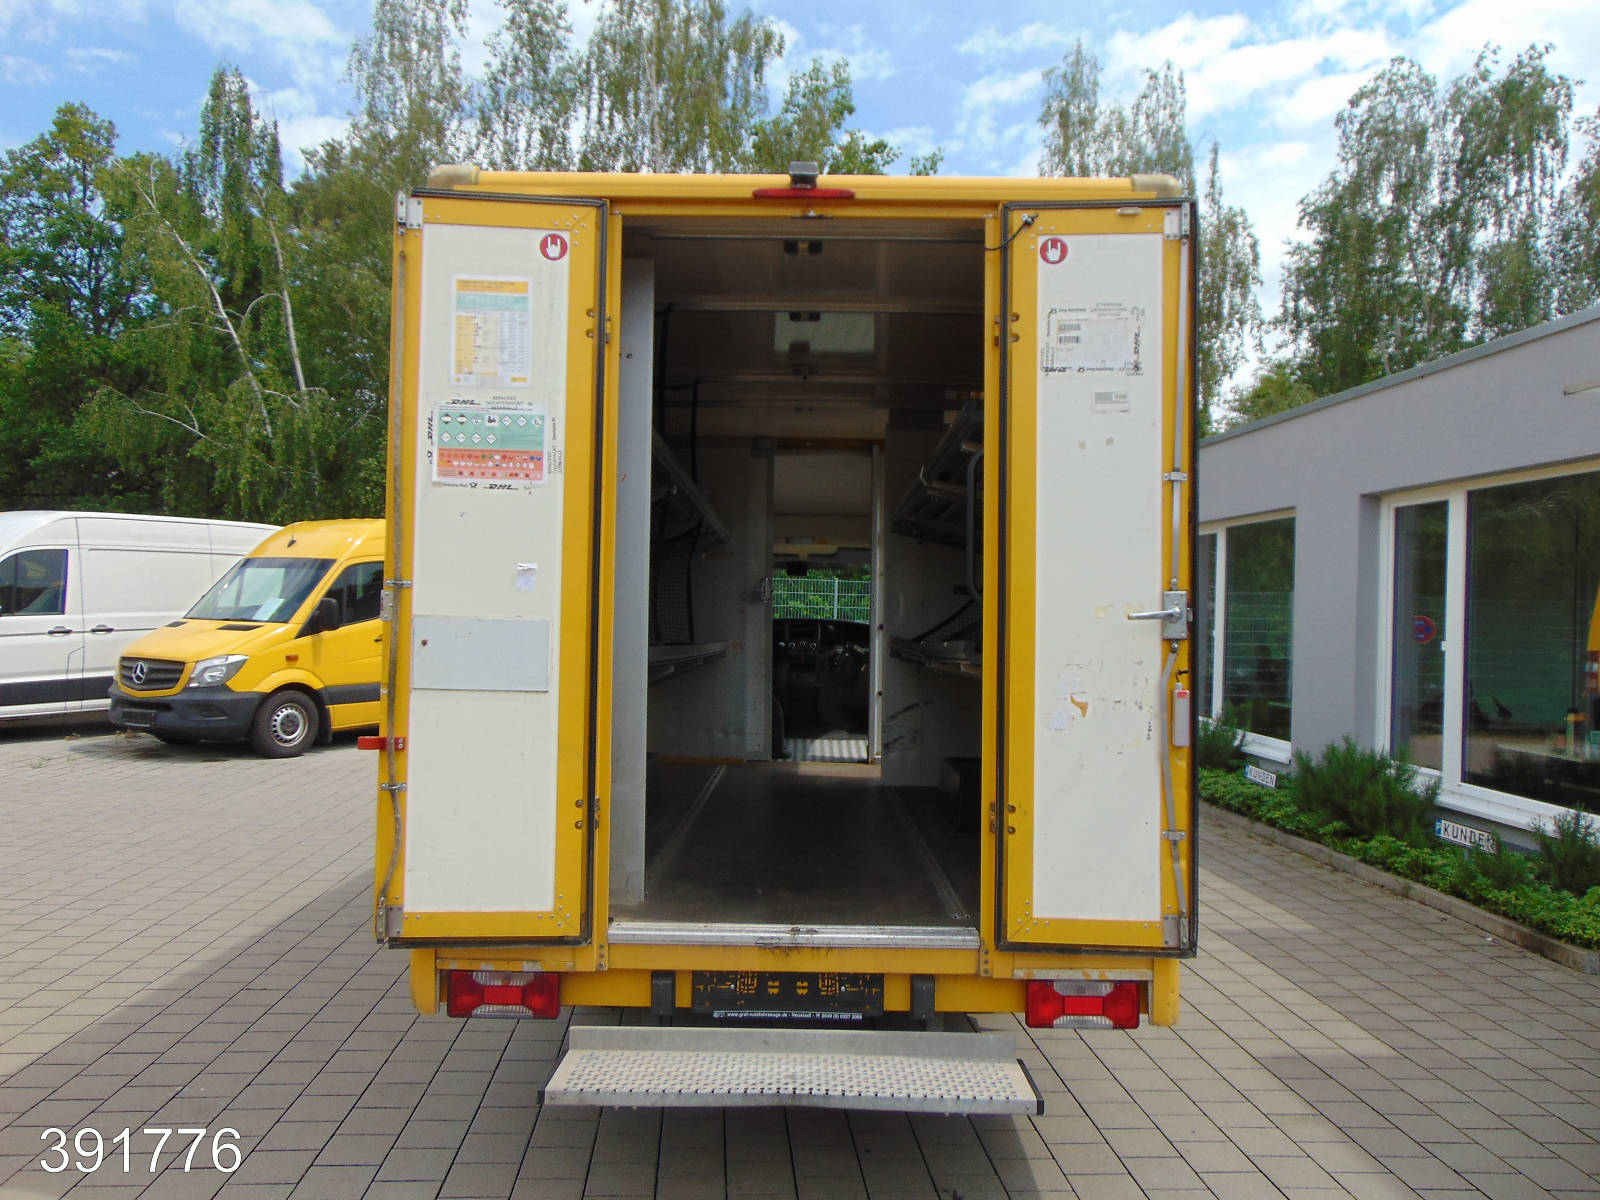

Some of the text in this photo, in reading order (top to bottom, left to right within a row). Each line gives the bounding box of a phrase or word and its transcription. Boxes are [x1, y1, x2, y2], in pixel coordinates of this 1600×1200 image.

[449, 398, 477, 406] DHL
[1248, 766, 1275, 786] KUNDEN
[1443, 822, 1496, 850] KUNDEN
